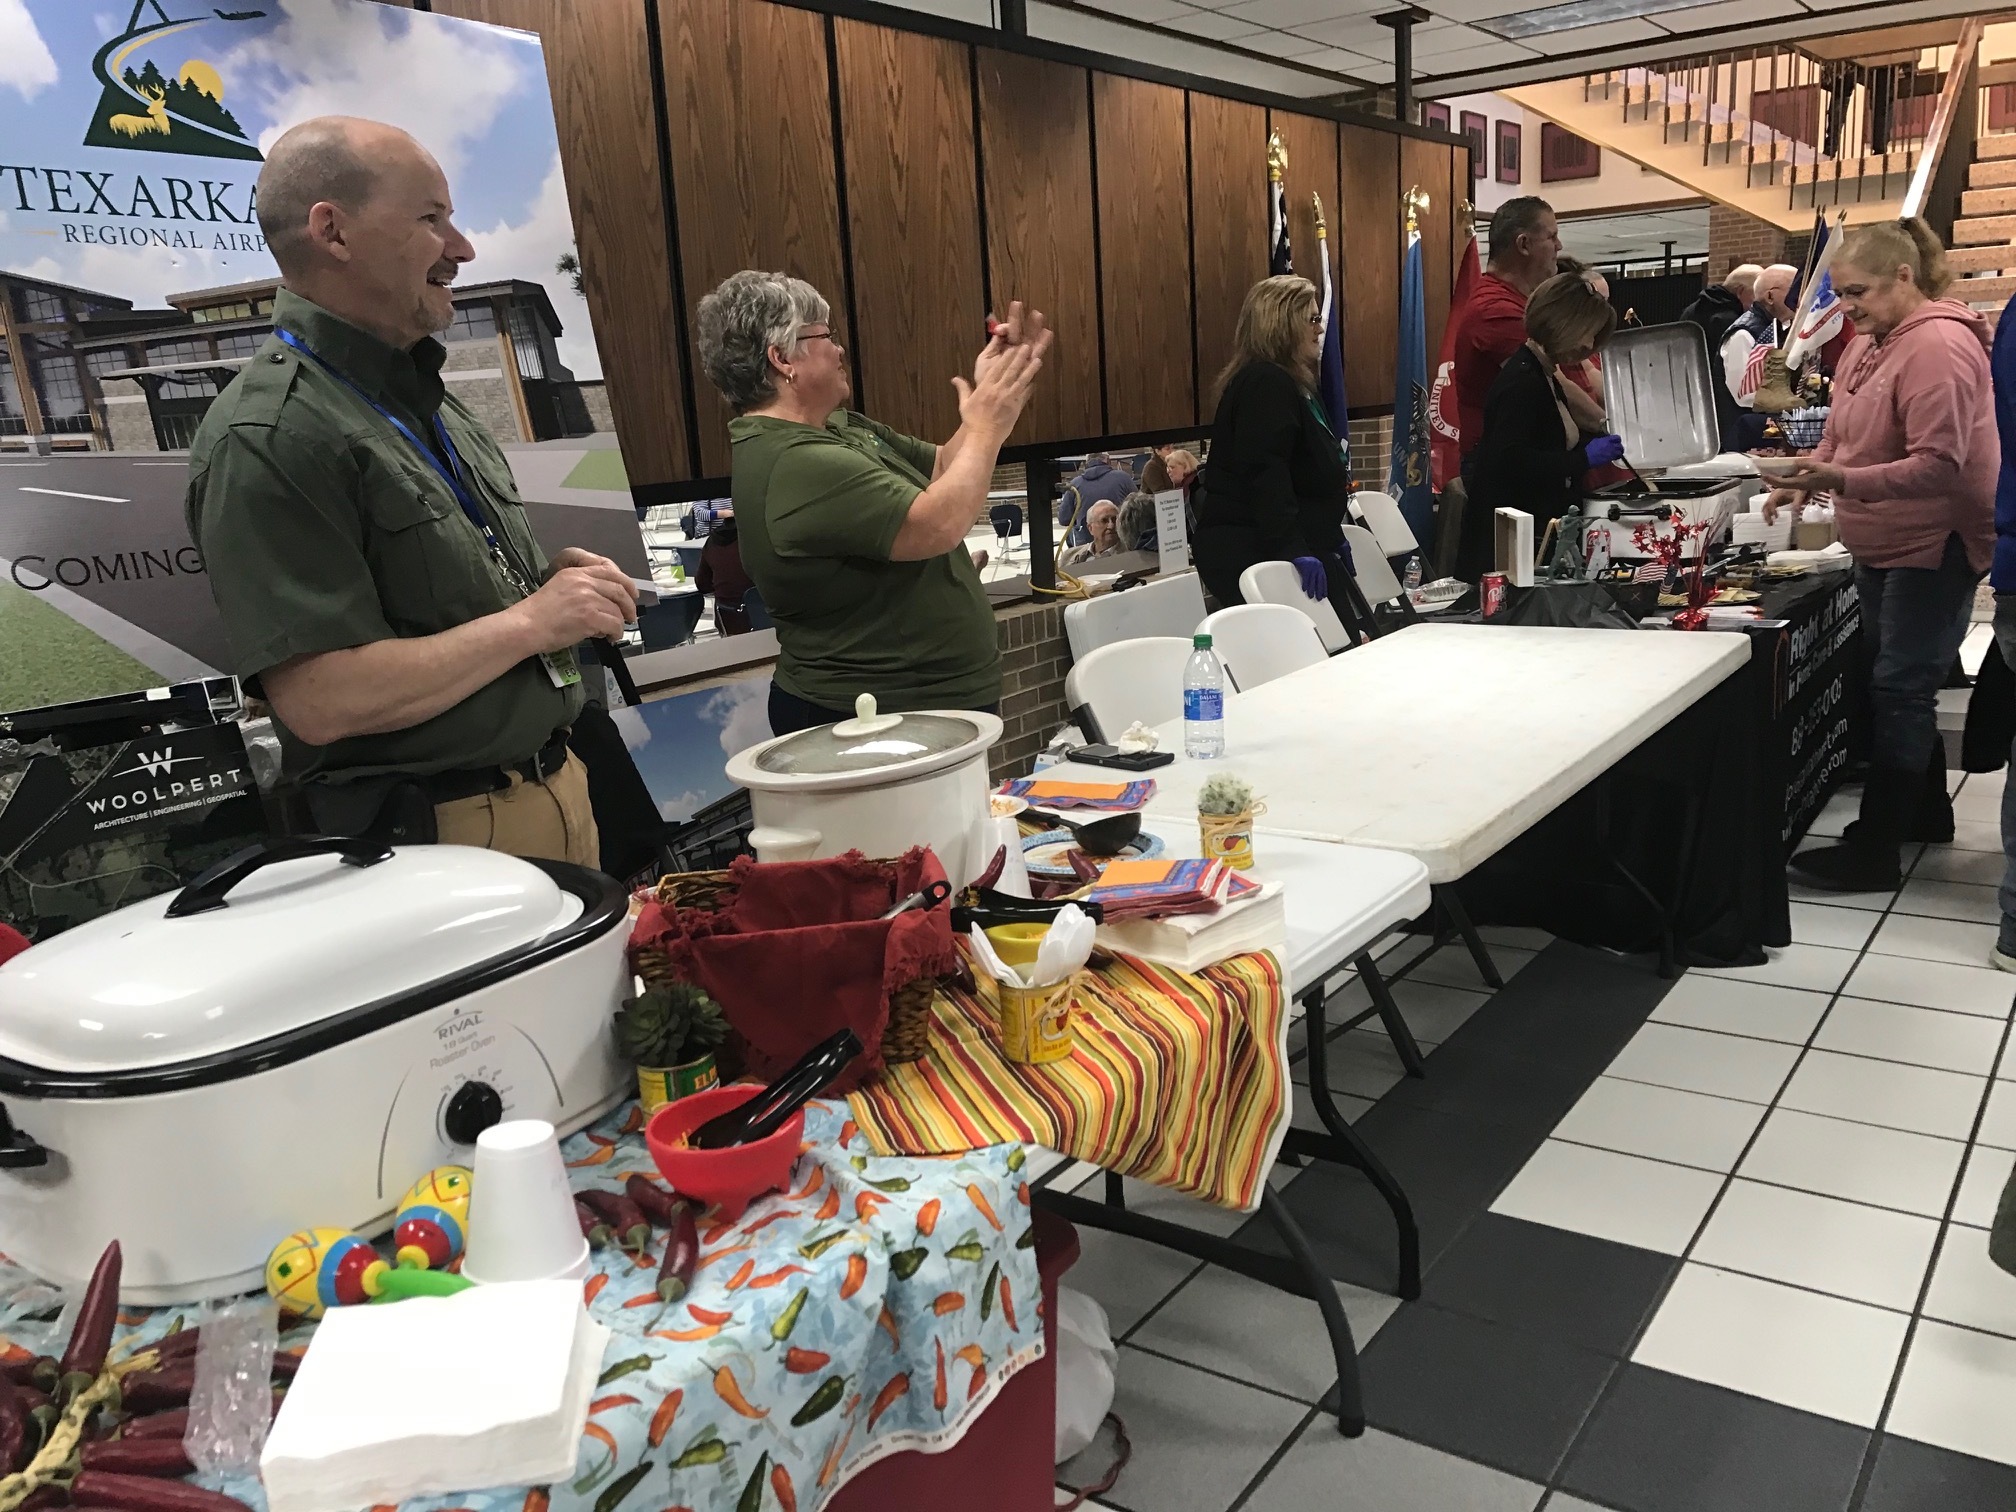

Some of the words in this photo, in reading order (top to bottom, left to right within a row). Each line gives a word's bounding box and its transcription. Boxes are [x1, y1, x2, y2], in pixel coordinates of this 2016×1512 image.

[62, 223, 203, 249] REGIONAL
[1430, 384, 1445, 431] UNITED
[11, 546, 204, 591] COMING
[1790, 611, 1819, 666] Right
[1822, 598, 1834, 632] at
[86, 769, 241, 815] WOOLPERT
[93, 811, 149, 831] ARCHITECTURE
[153, 799, 203, 817] ENGINEERING
[206, 789, 248, 804] GEOSPATIAL
[438, 1014, 484, 1041] RIVAL
[429, 1047, 468, 1069] Roaster
[470, 1035, 496, 1052] Oven
